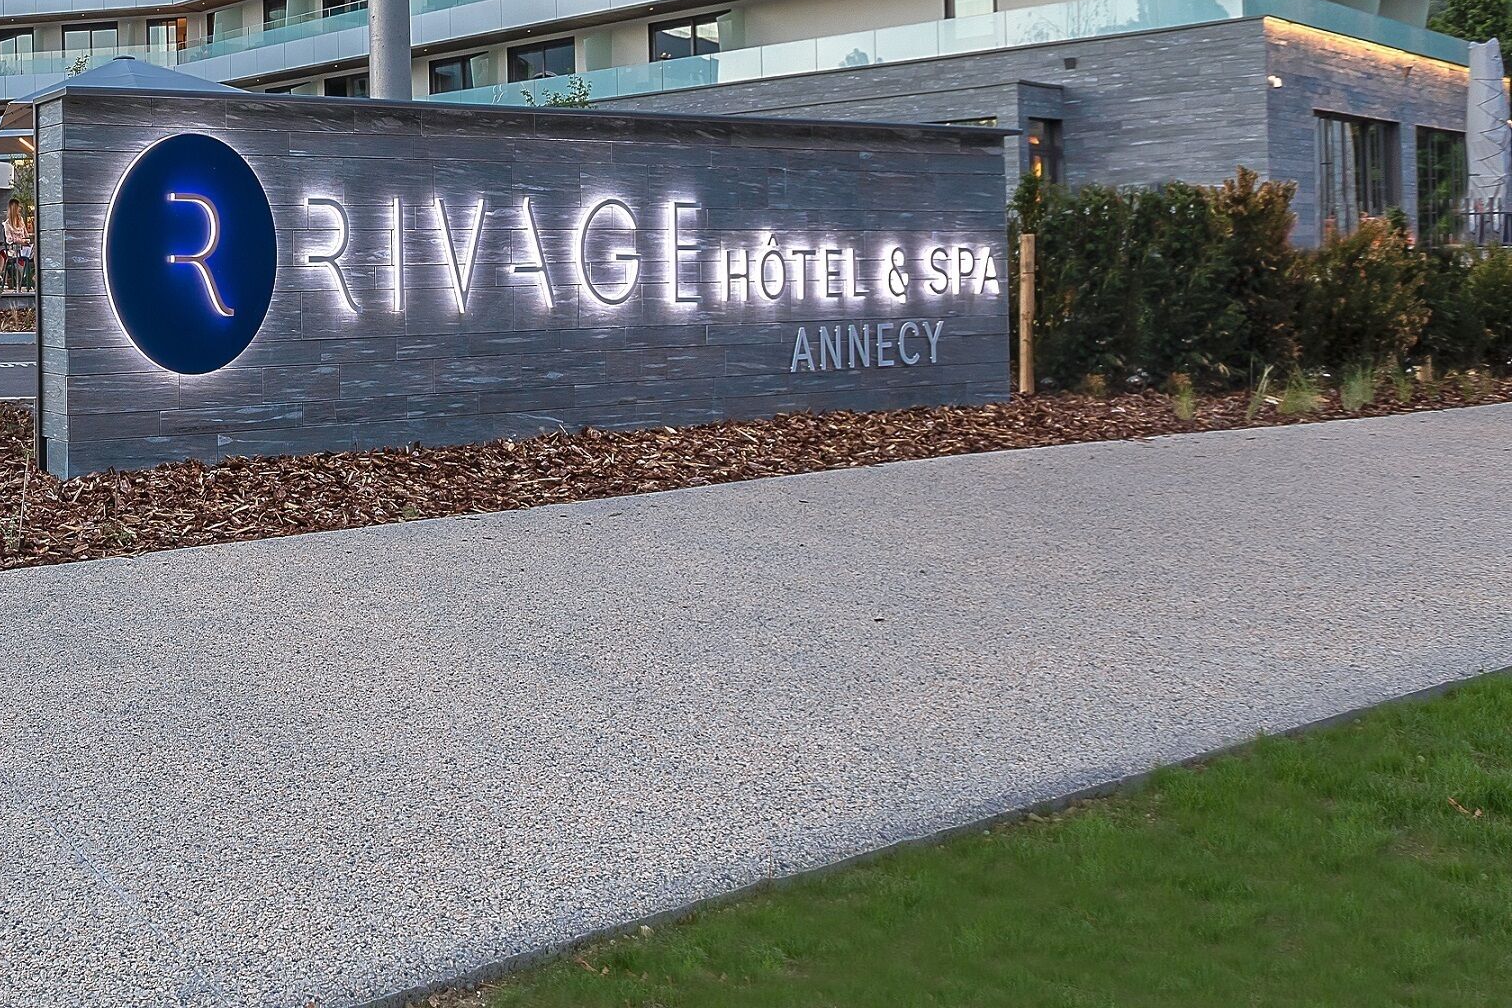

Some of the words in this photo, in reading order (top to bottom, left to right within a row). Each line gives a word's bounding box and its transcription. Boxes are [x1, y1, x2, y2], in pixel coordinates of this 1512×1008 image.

[166, 192, 236, 318] R
[303, 195, 703, 314] RIVAGE
[721, 233, 870, 304] HÔTEL
[885, 245, 910, 304] &
[922, 245, 1001, 296] SPA
[790, 320, 945, 374] ANNECY
